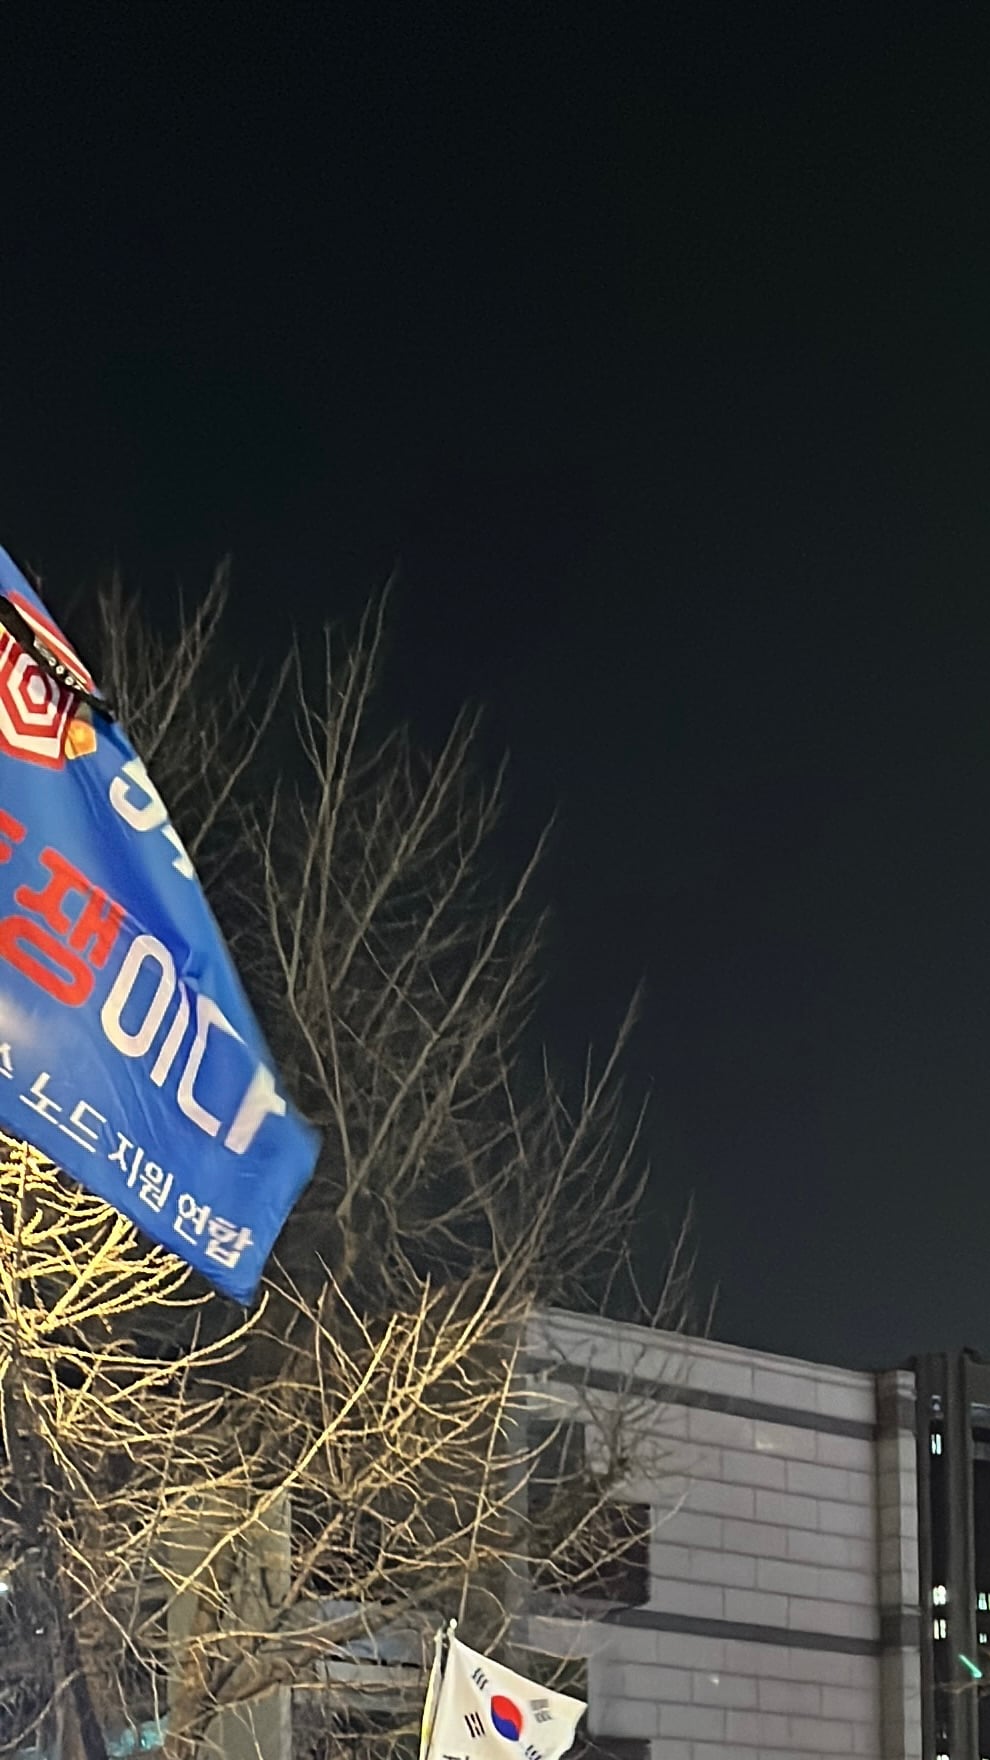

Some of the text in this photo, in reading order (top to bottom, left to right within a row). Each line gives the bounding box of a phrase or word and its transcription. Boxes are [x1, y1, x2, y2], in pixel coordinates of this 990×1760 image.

[0, 815, 286, 1155] 쟁이다
[107, 1131, 174, 1213] 지원
[173, 1193, 254, 1269] 연합
